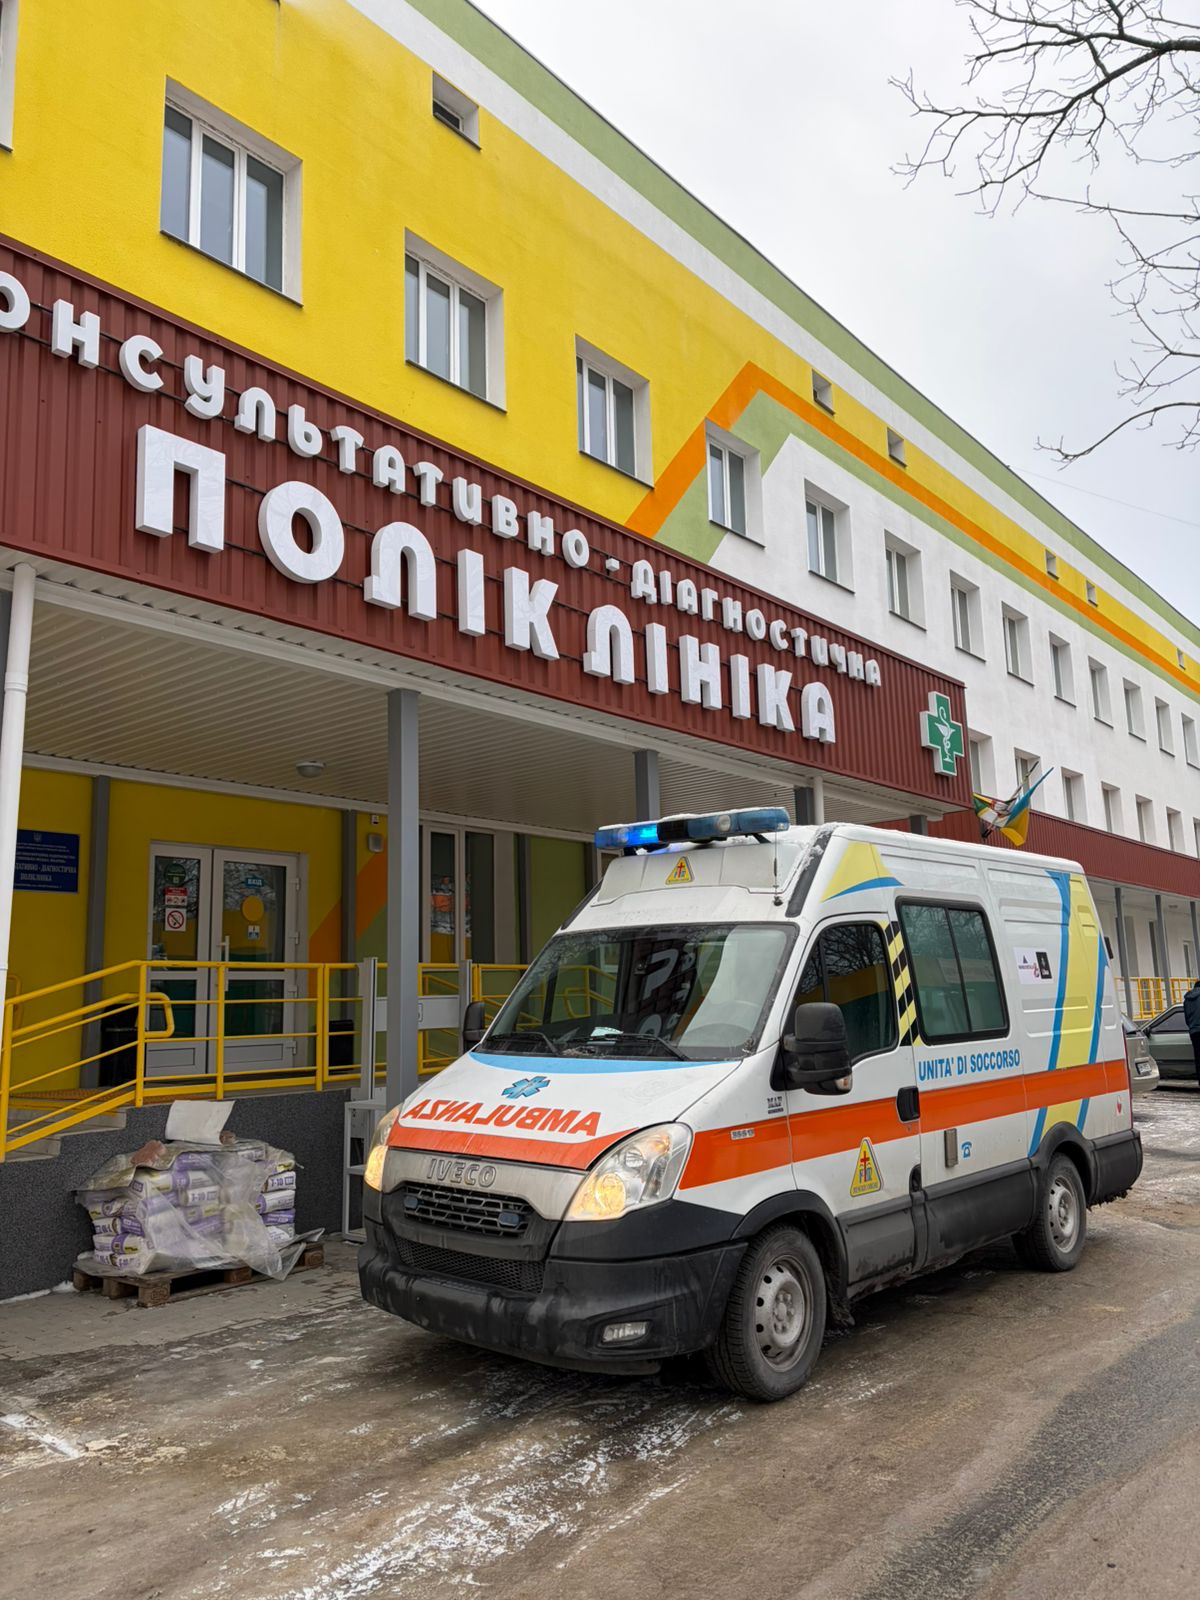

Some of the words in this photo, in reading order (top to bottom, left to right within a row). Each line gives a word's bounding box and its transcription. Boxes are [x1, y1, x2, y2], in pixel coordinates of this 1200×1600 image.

[136, 424, 836, 744] ПОЛІКЛІНІКА
[919, 1056, 954, 1082] UNITA'
[957, 1055, 967, 1075] DI
[970, 1048, 1021, 1073] SOCCORSO
[427, 1158, 497, 1188] IVECO
